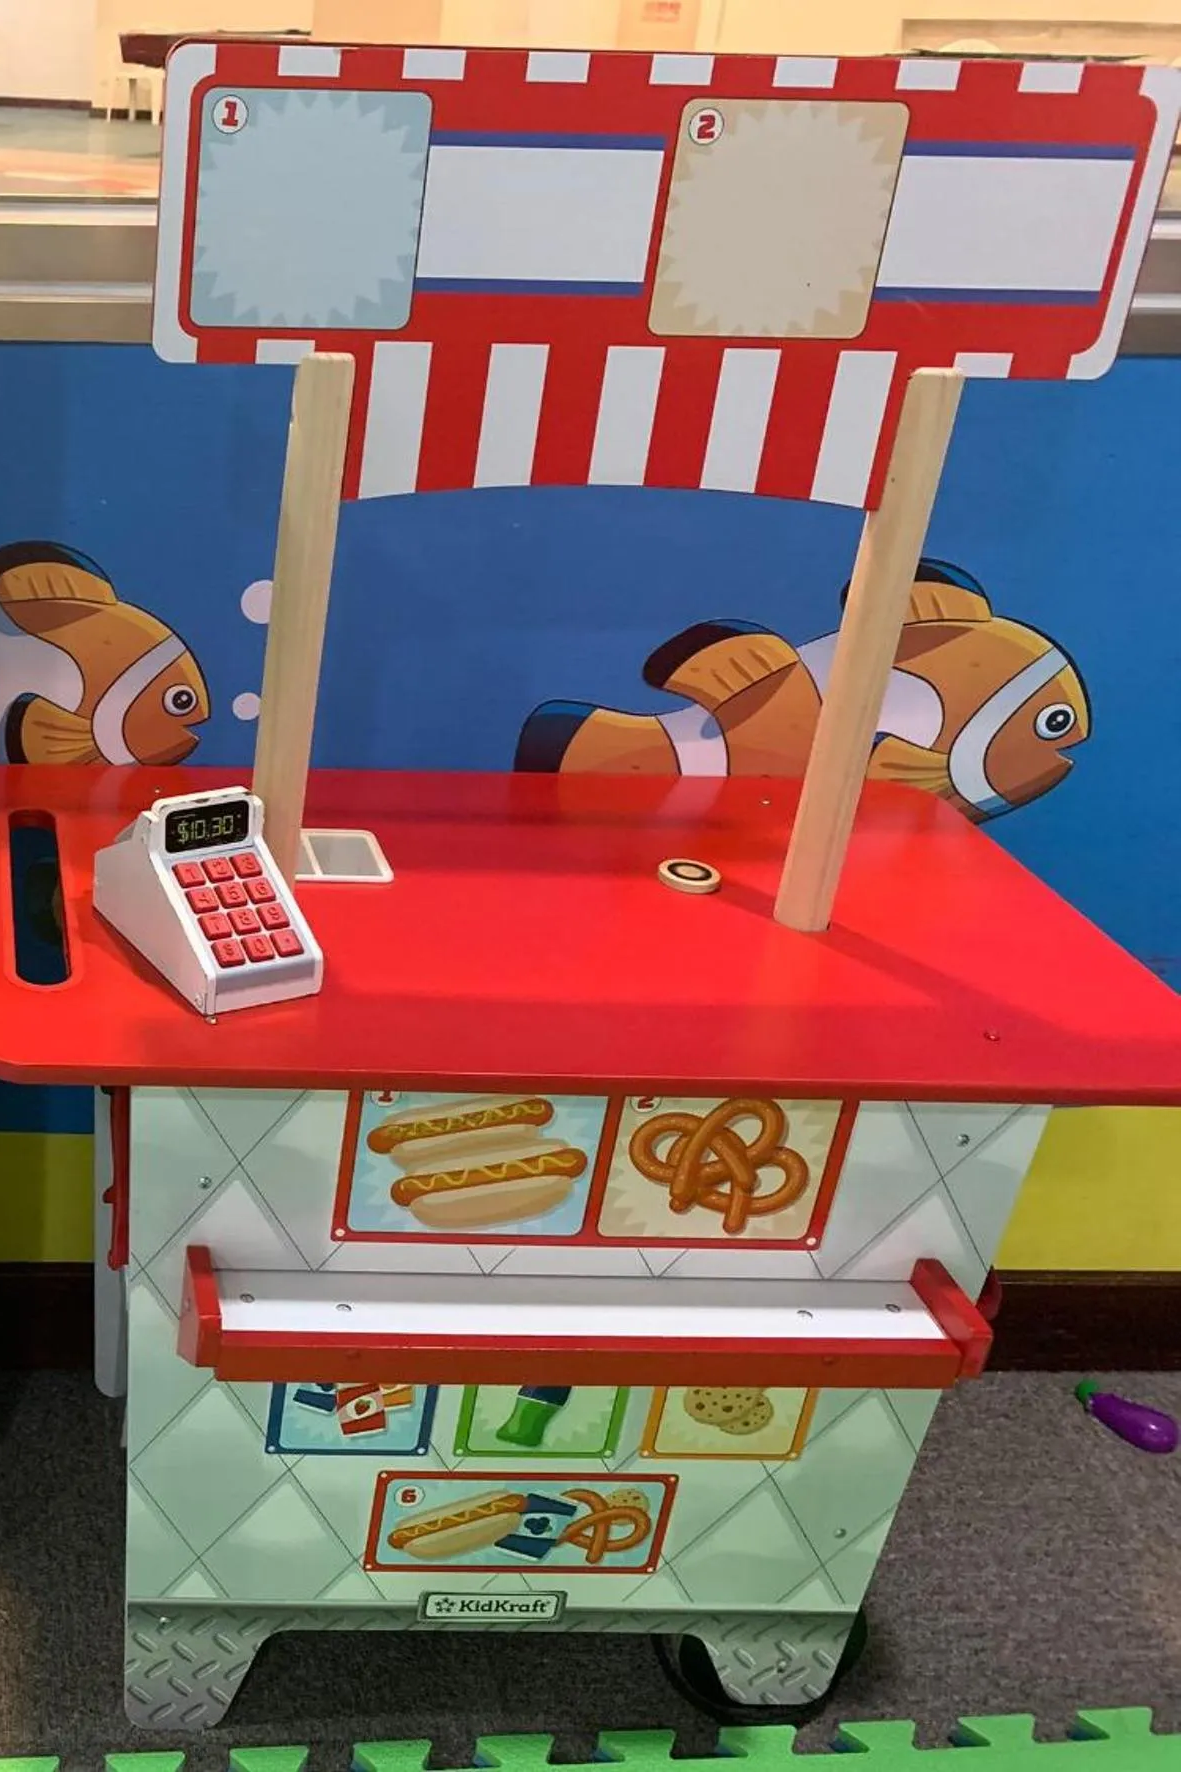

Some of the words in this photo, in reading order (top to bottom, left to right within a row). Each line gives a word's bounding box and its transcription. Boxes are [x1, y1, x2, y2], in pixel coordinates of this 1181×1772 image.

[221, 100, 239, 127] 1
[697, 114, 716, 139] 2
[177, 814, 234, 845] $10.30
[400, 1488, 418, 1504] 6
[458, 1598, 548, 1614] KidKraft
